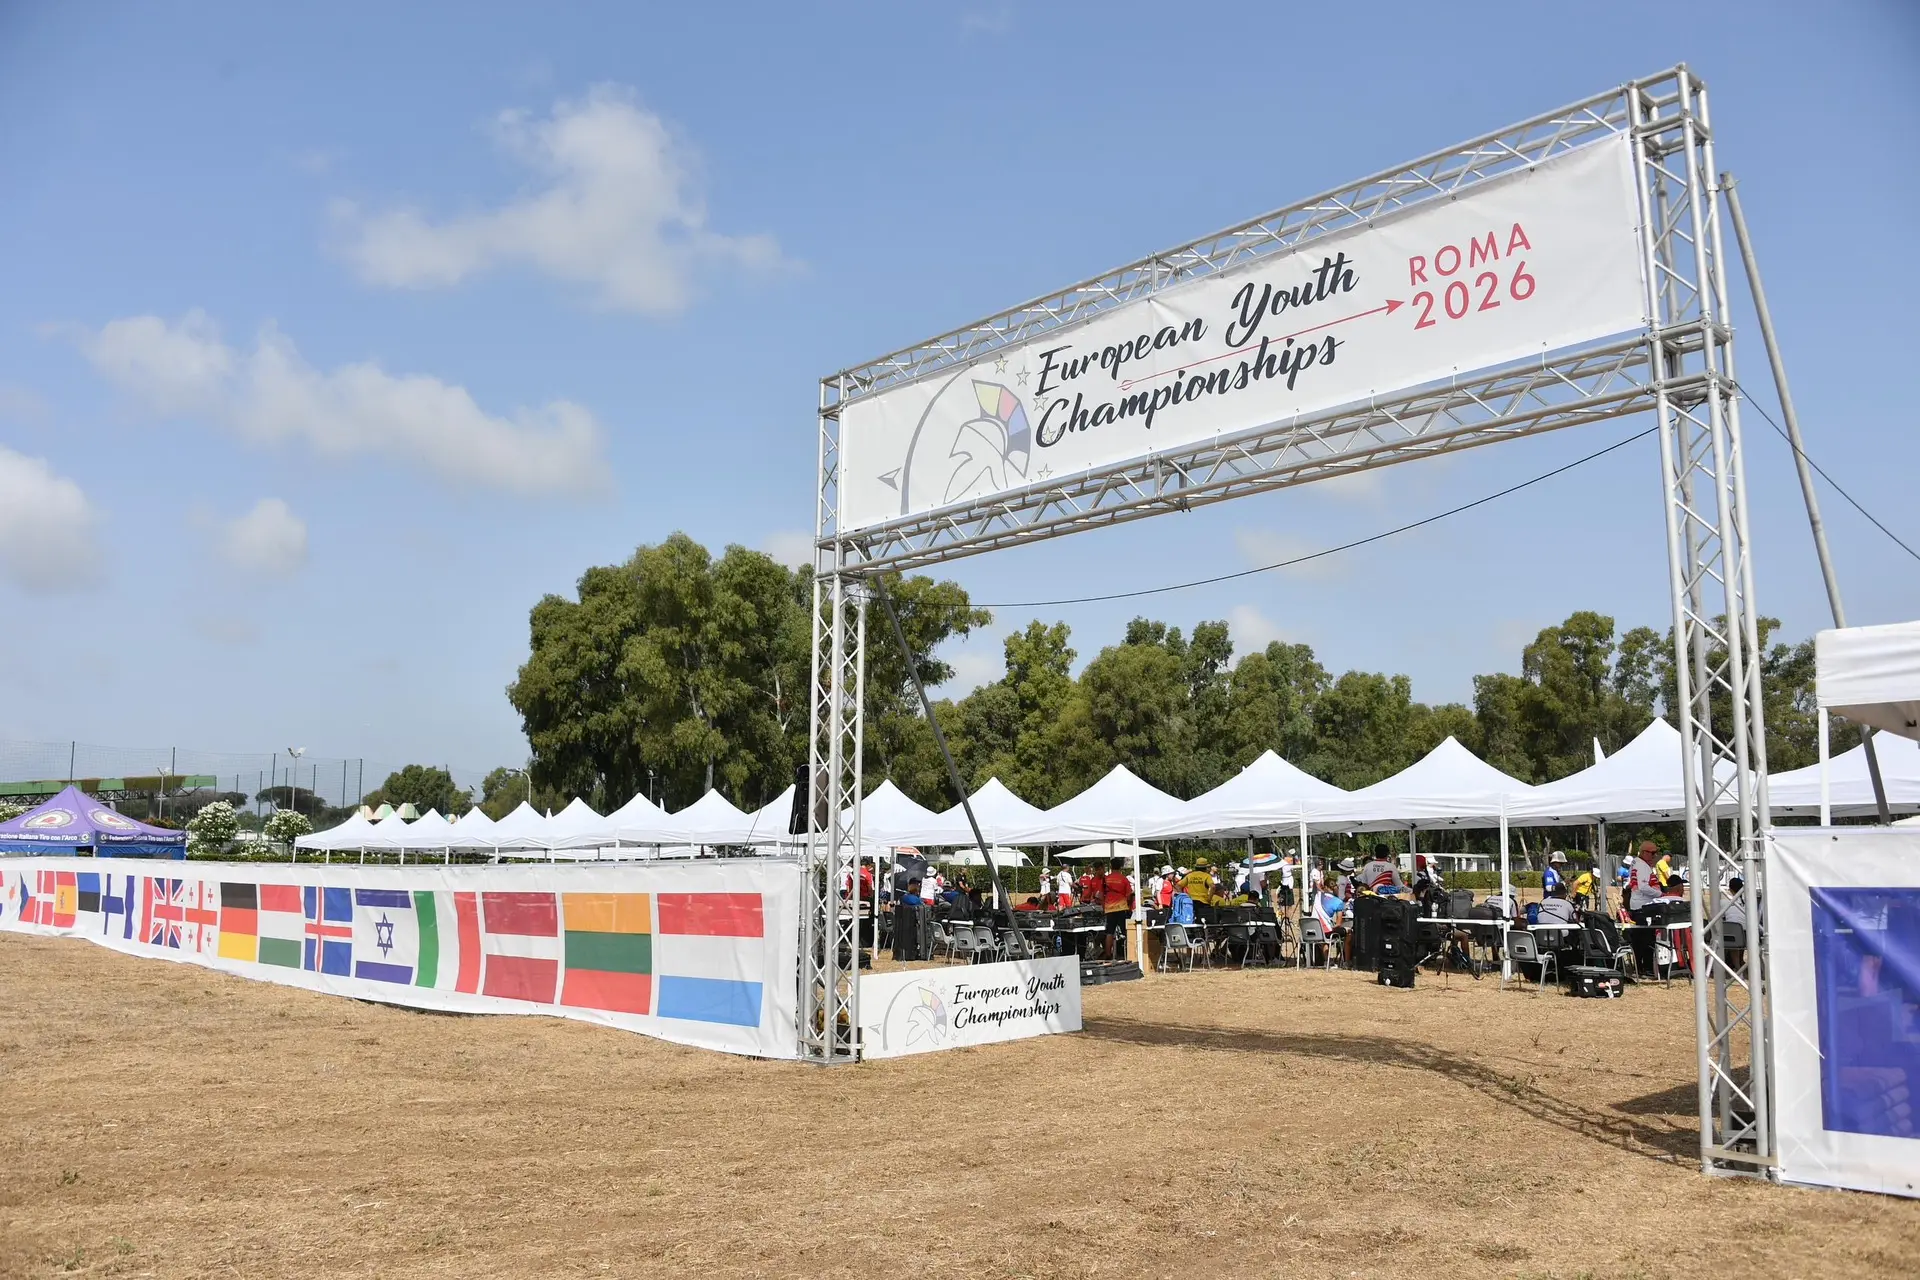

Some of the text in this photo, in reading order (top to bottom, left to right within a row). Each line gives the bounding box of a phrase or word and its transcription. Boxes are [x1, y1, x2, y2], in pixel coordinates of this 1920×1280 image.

[1409, 223, 1531, 286] ROMA
[1034, 252, 1360, 397] European Youth
[1412, 261, 1535, 330] 2026
[1036, 336, 1345, 447] Championships
[953, 973, 1065, 1005] European Youth
[954, 998, 1062, 1029] Championships
